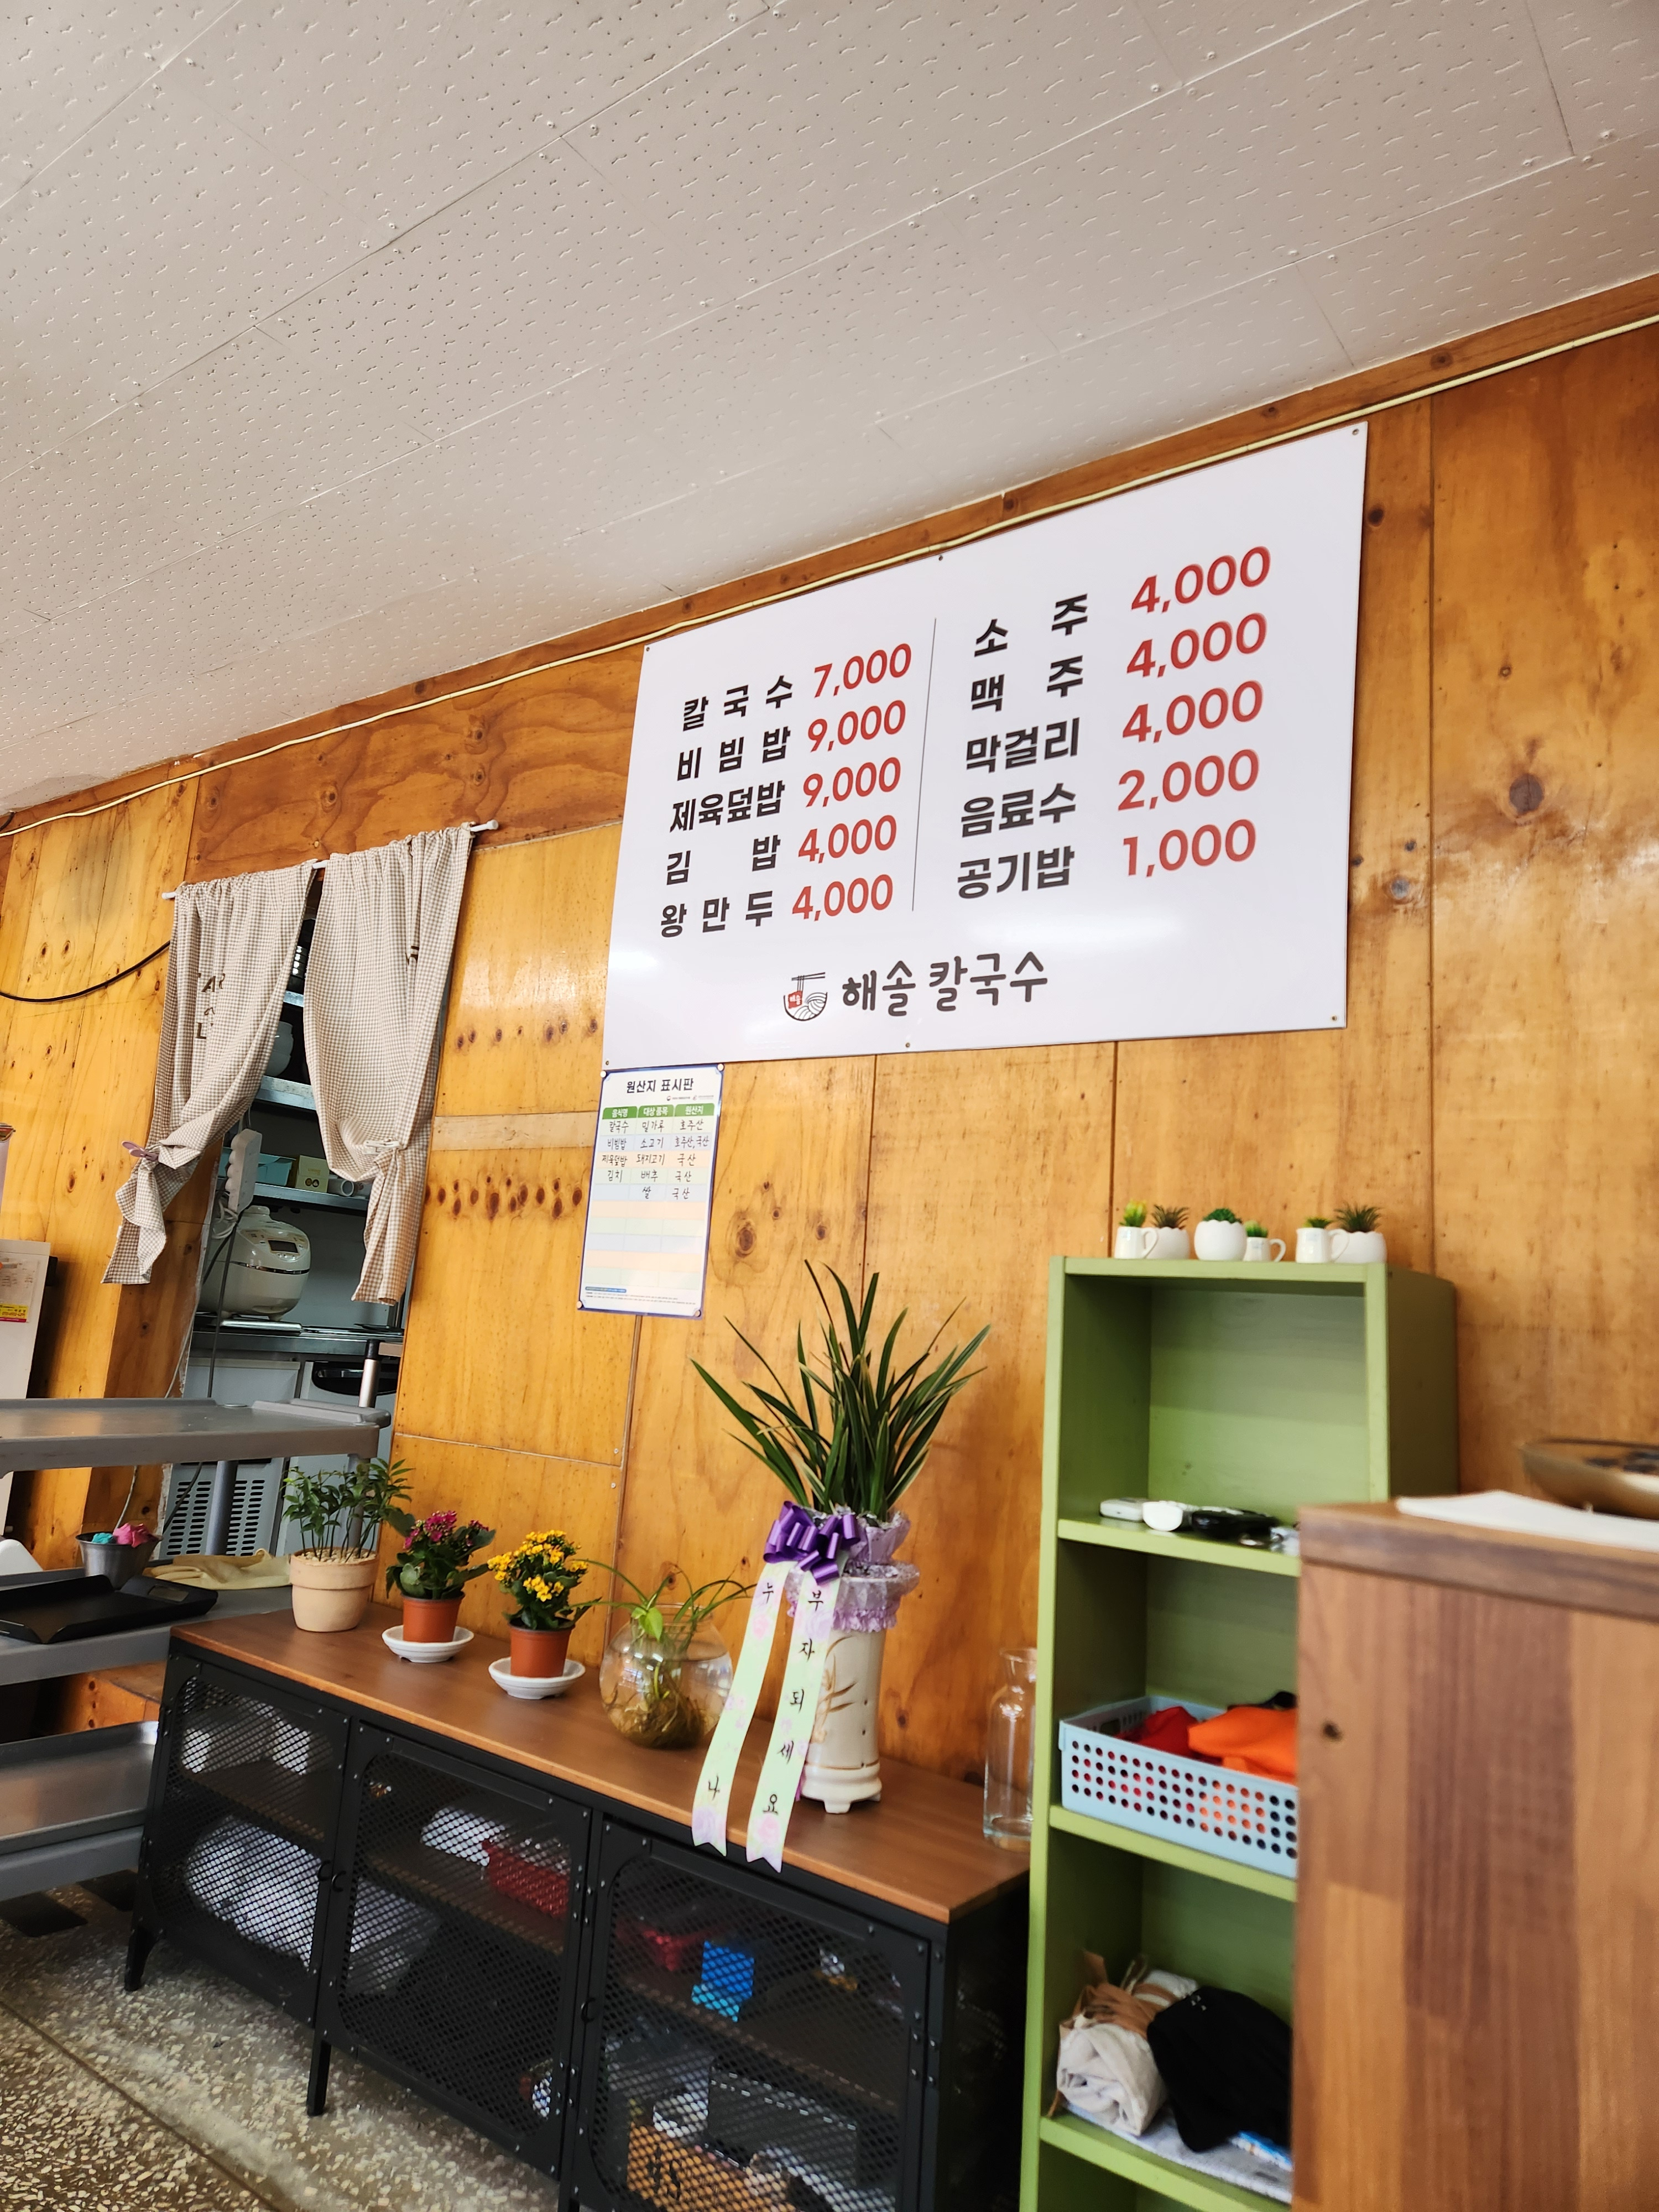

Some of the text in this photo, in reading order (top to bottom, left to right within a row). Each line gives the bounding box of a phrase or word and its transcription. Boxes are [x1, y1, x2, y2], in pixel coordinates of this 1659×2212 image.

[1131, 546, 1270, 613] 4,000
[1126, 613, 1266, 678] 4,000
[814, 643, 911, 698] 7,000
[807, 700, 906, 753] 9,000
[966, 680, 1262, 774] 막걸리 4,000
[670, 757, 901, 833] 제육덮밥 9,000
[961, 749, 1259, 838] 음료수 2,000
[798, 815, 897, 864] 4,000
[957, 819, 1256, 899] 공기밥 1,000
[792, 874, 893, 922] 4,000
[842, 951, 1048, 1018] 해솔 칼국수
[627, 1078, 694, 1093] 원산지 표시판
[612, 1108, 628, 1118] 음식명
[685, 1105, 704, 1115] 원산지
[609, 1120, 629, 1134] 칼국수
[642, 1119, 665, 1133] 밀가루
[680, 1118, 704, 1131] 호주산
[607, 1137, 627, 1150] 비빔밥
[640, 1137, 664, 1149] 소고기
[636, 1153, 665, 1166] 돼지고기
[677, 1153, 696, 1166] 국산
[607, 1170, 623, 1183] 김치
[640, 1169, 658, 1182] 배추
[675, 1170, 692, 1182] 국산
[642, 1186, 651, 1199] 쌀
[672, 1187, 690, 1200] 국산
